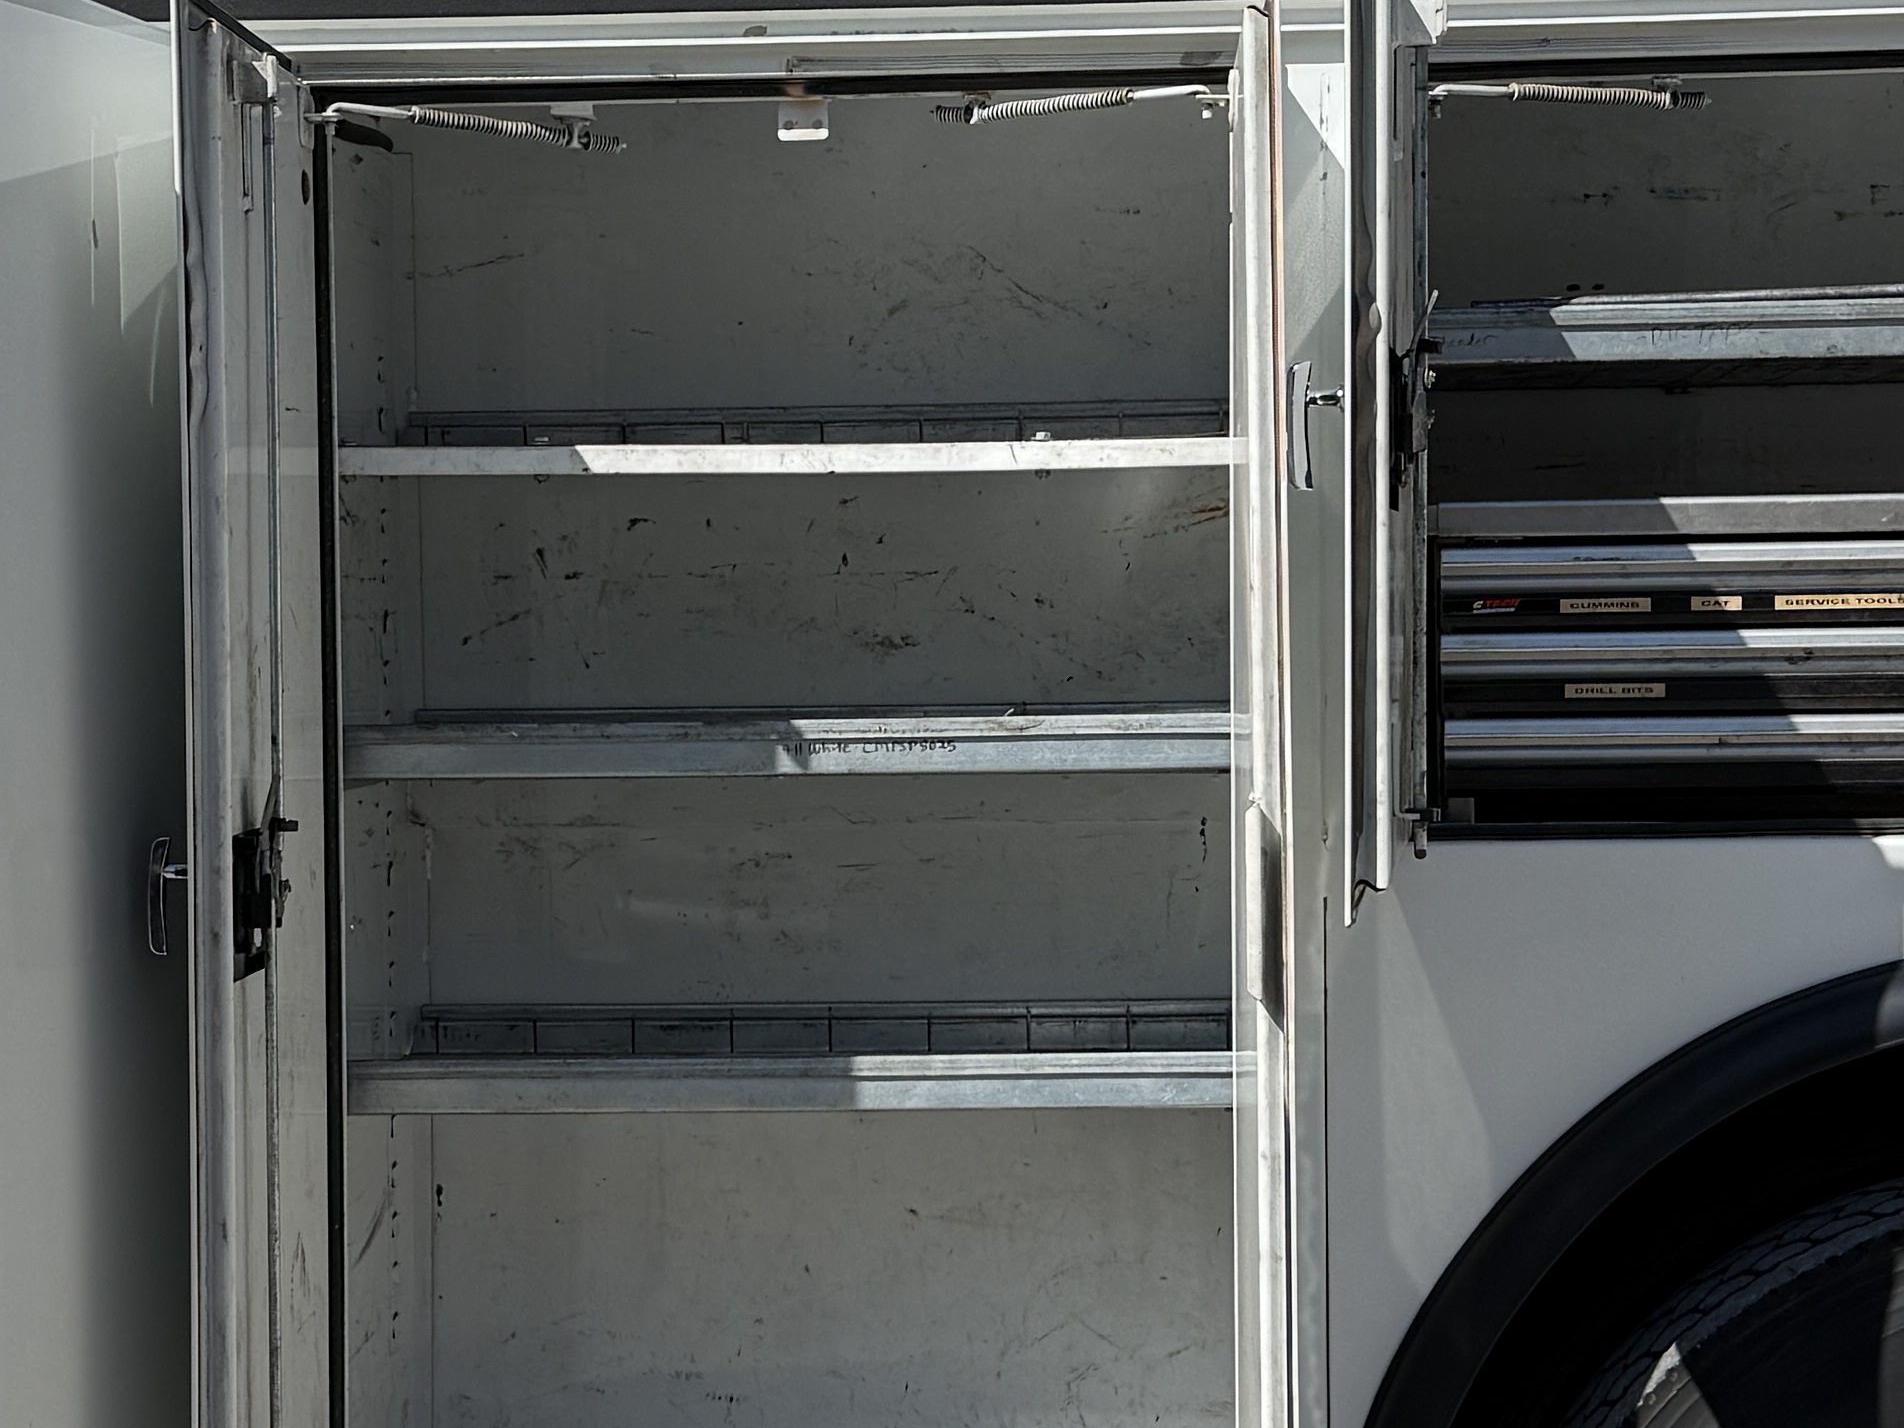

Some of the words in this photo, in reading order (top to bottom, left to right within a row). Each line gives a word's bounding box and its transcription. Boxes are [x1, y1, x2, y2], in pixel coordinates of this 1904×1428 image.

[1700, 598, 1730, 608] CAT
[1784, 597, 1851, 607] SERVICE
[1574, 686, 1616, 696] DRILL
[1622, 685, 1655, 695] BITS
